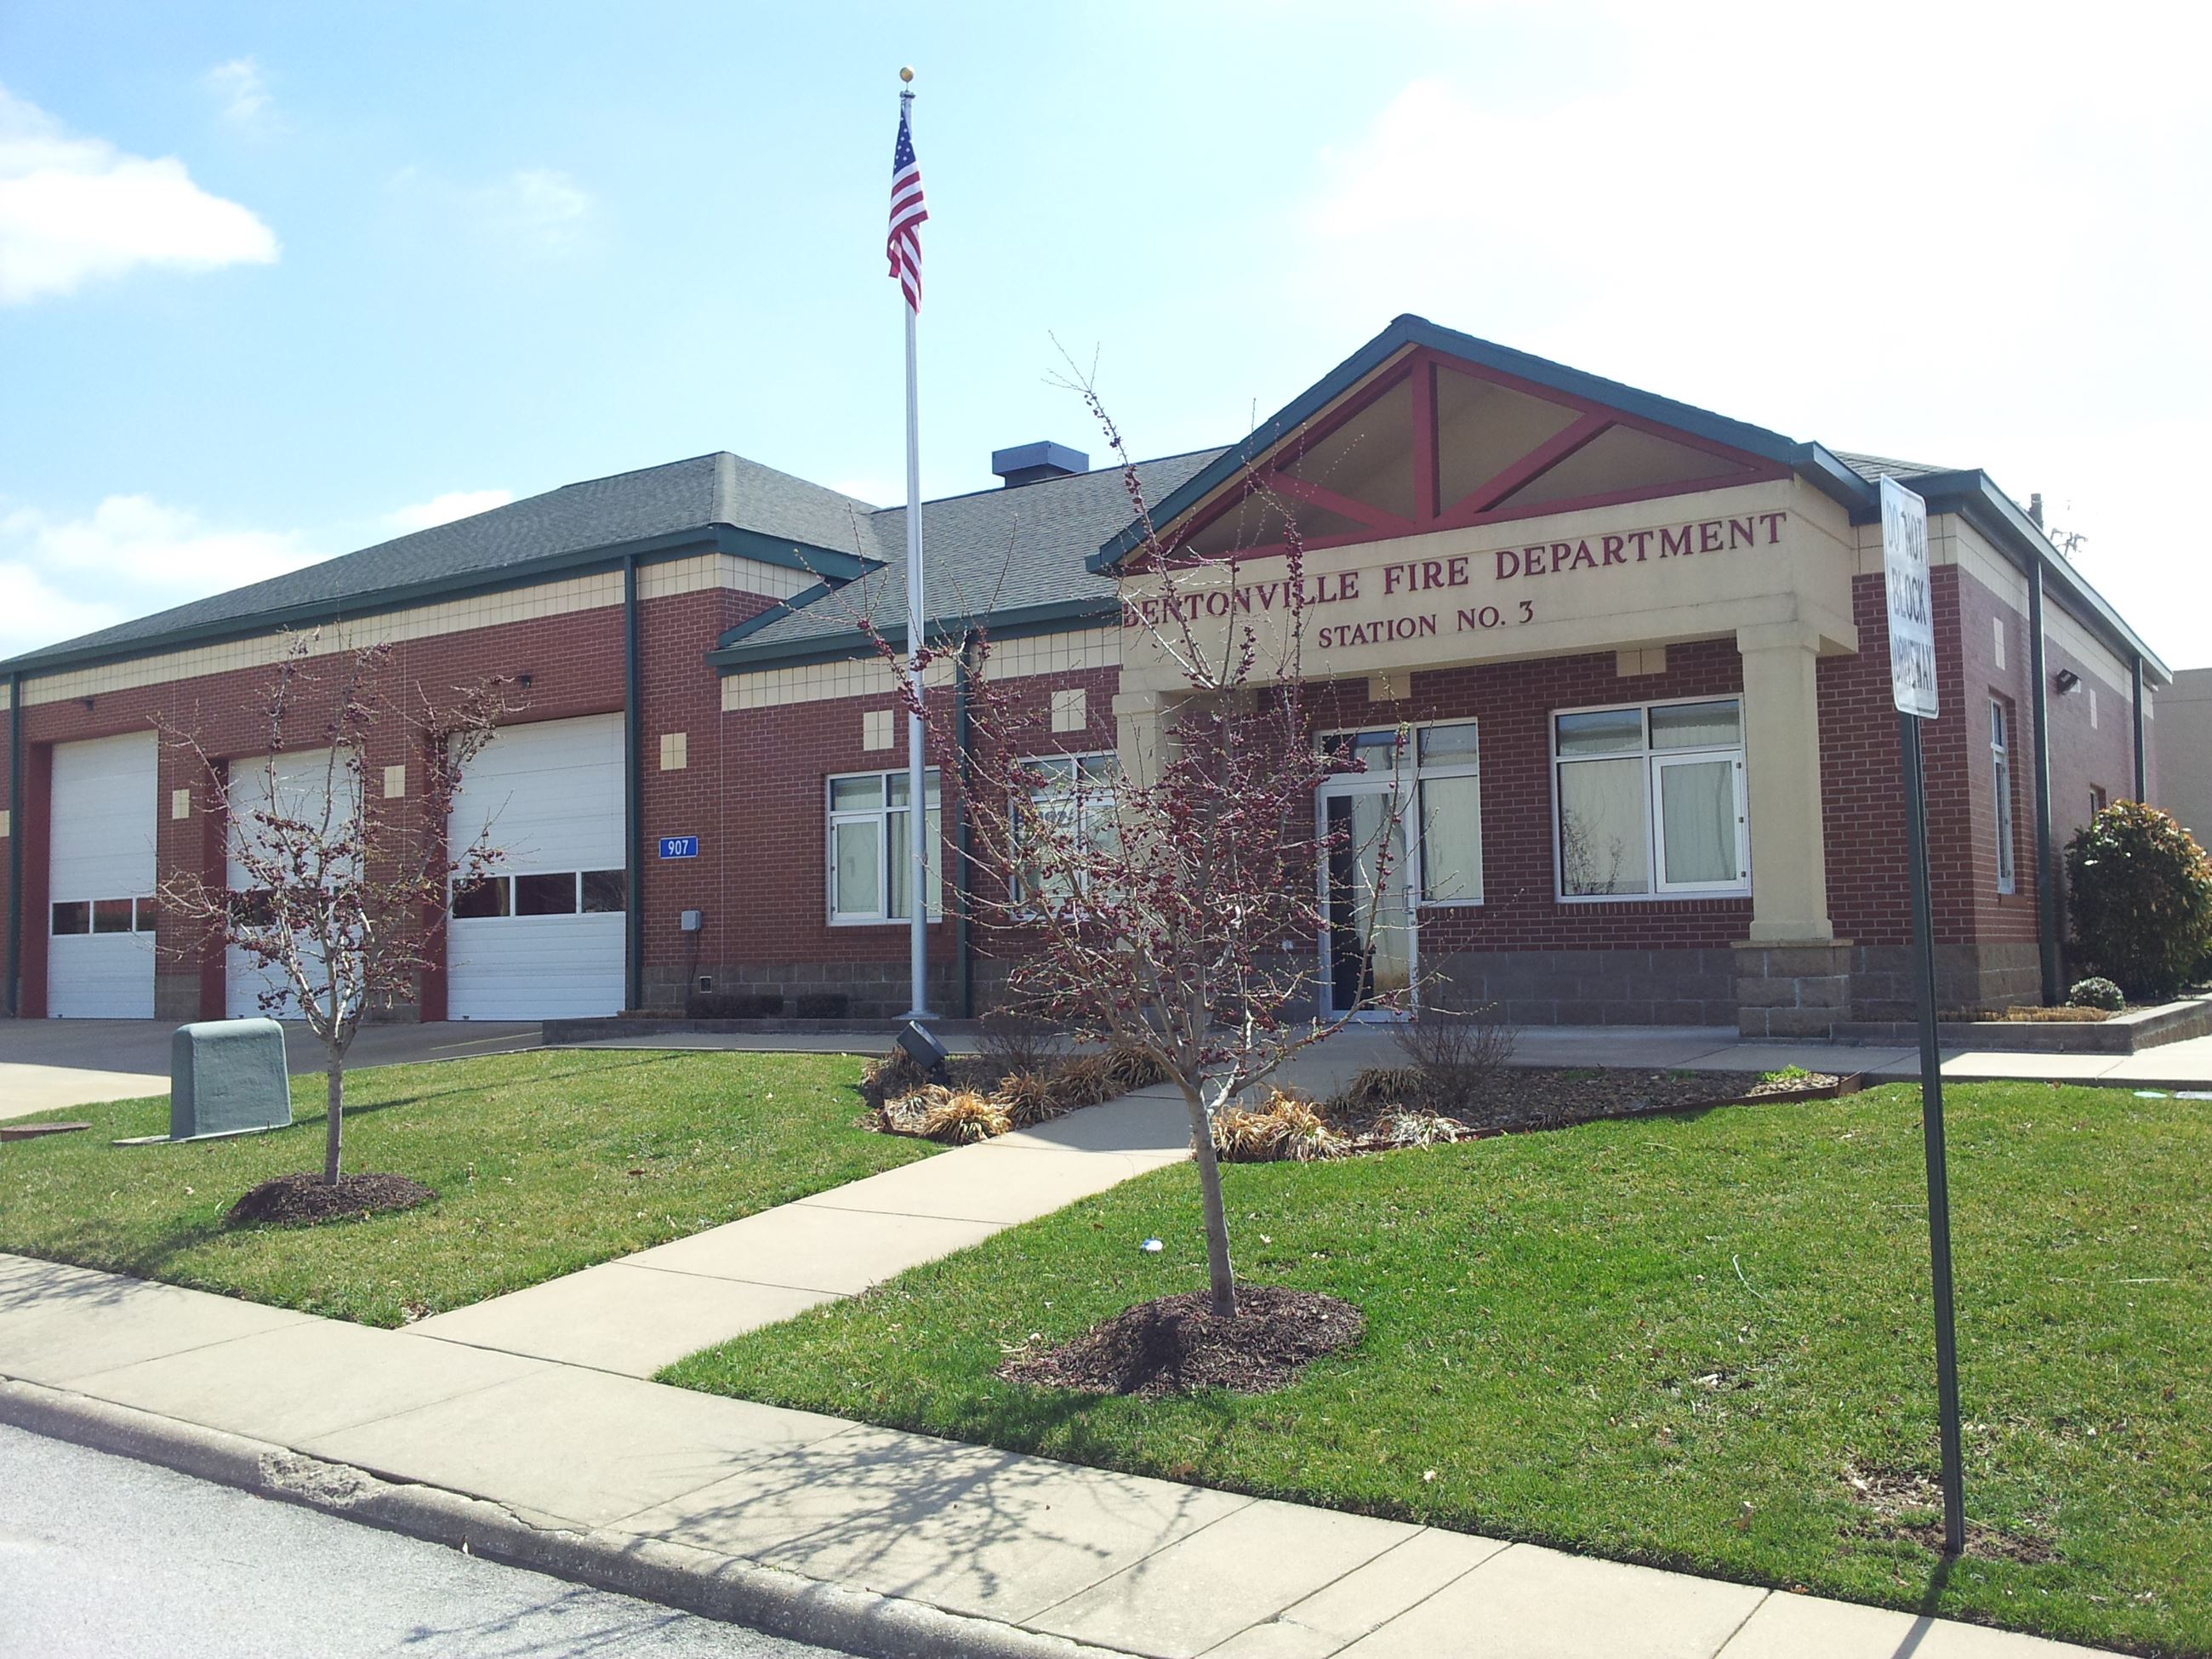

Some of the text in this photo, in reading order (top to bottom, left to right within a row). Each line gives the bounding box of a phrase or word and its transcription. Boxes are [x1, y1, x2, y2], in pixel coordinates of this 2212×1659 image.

[1886, 499, 1923, 563] DO NOT
[1122, 511, 1787, 629] BENTONVILLE FIRE DEPARTMENT
[1891, 566, 1927, 625] BLOCK
[1318, 600, 1533, 648] STATION NO. 3
[1893, 634, 1933, 692] DRIVEWAY
[668, 840, 689, 855] 907
